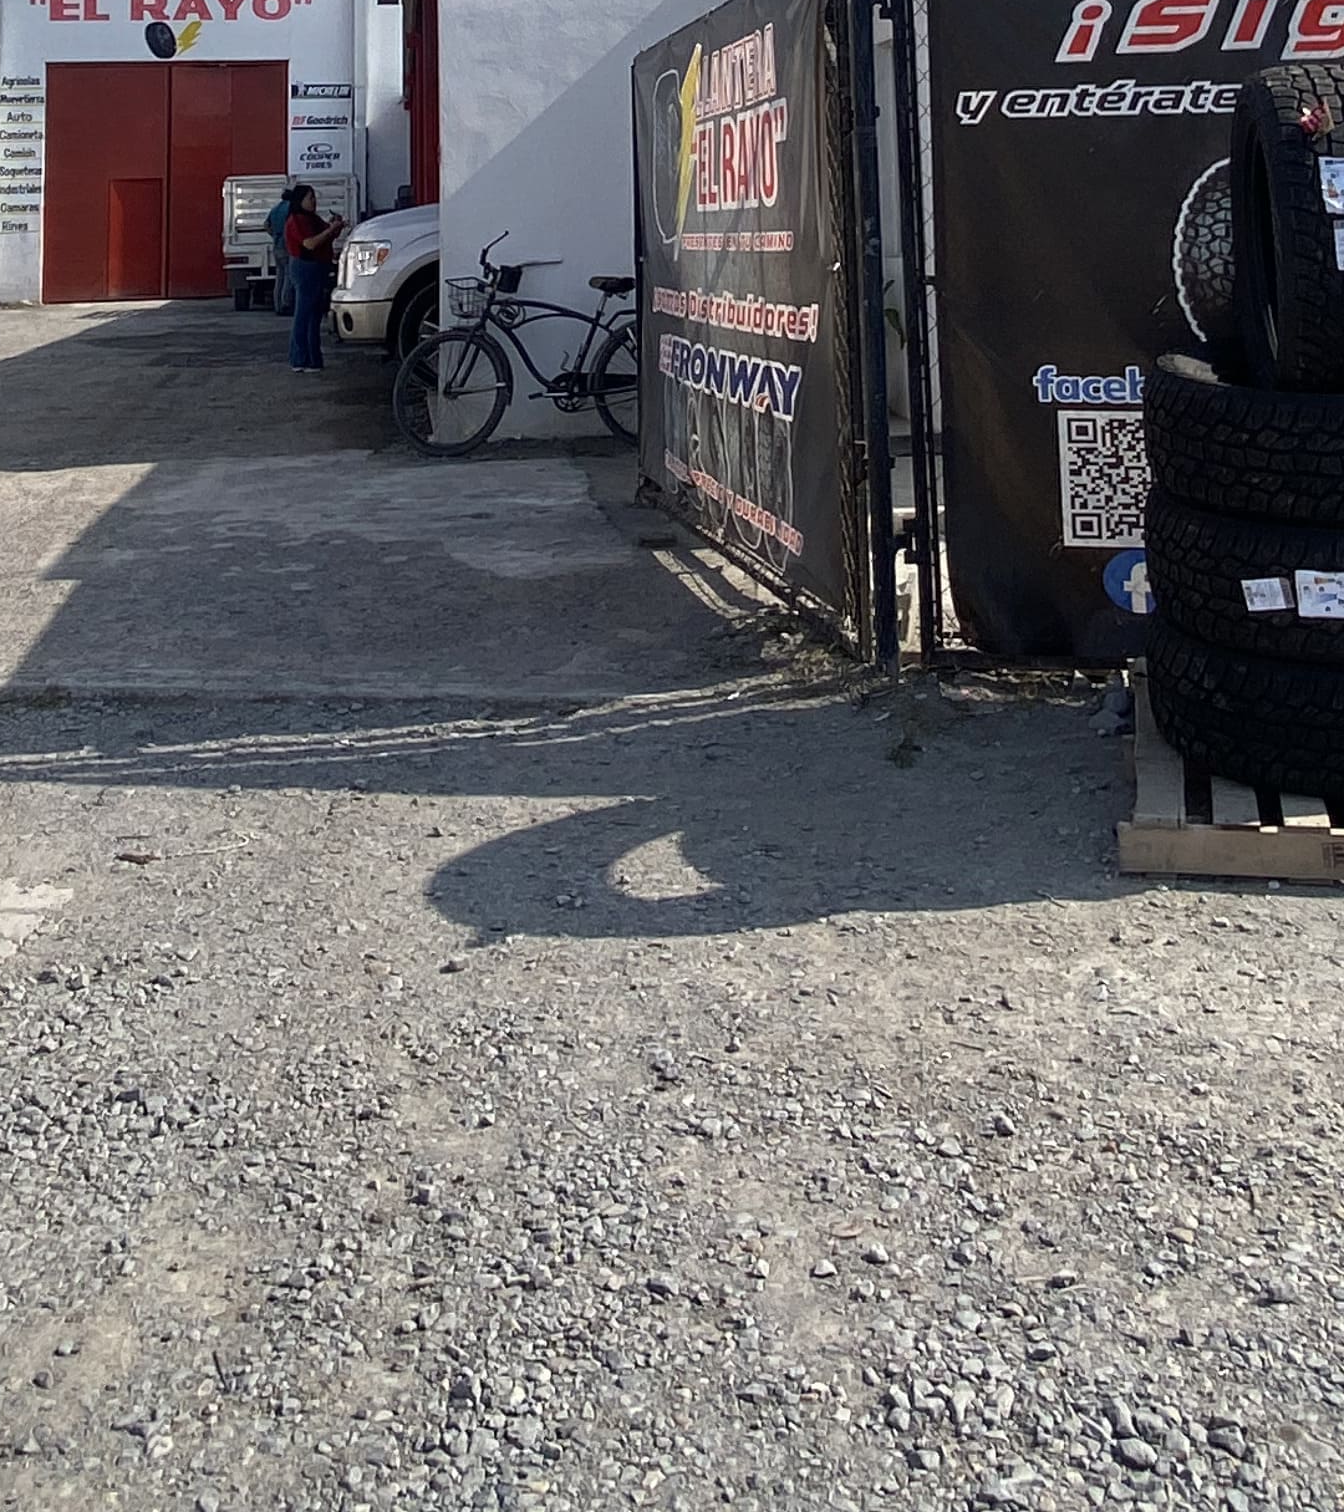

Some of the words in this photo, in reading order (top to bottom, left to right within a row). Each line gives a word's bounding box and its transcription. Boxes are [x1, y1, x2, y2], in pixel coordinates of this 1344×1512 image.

[6, 110, 33, 122] Auto
[956, 89, 997, 125] y
[1000, 79, 1243, 119] entérate
[753, 231, 794, 251] CAMINO
[671, 335, 802, 423] FRONWAY
